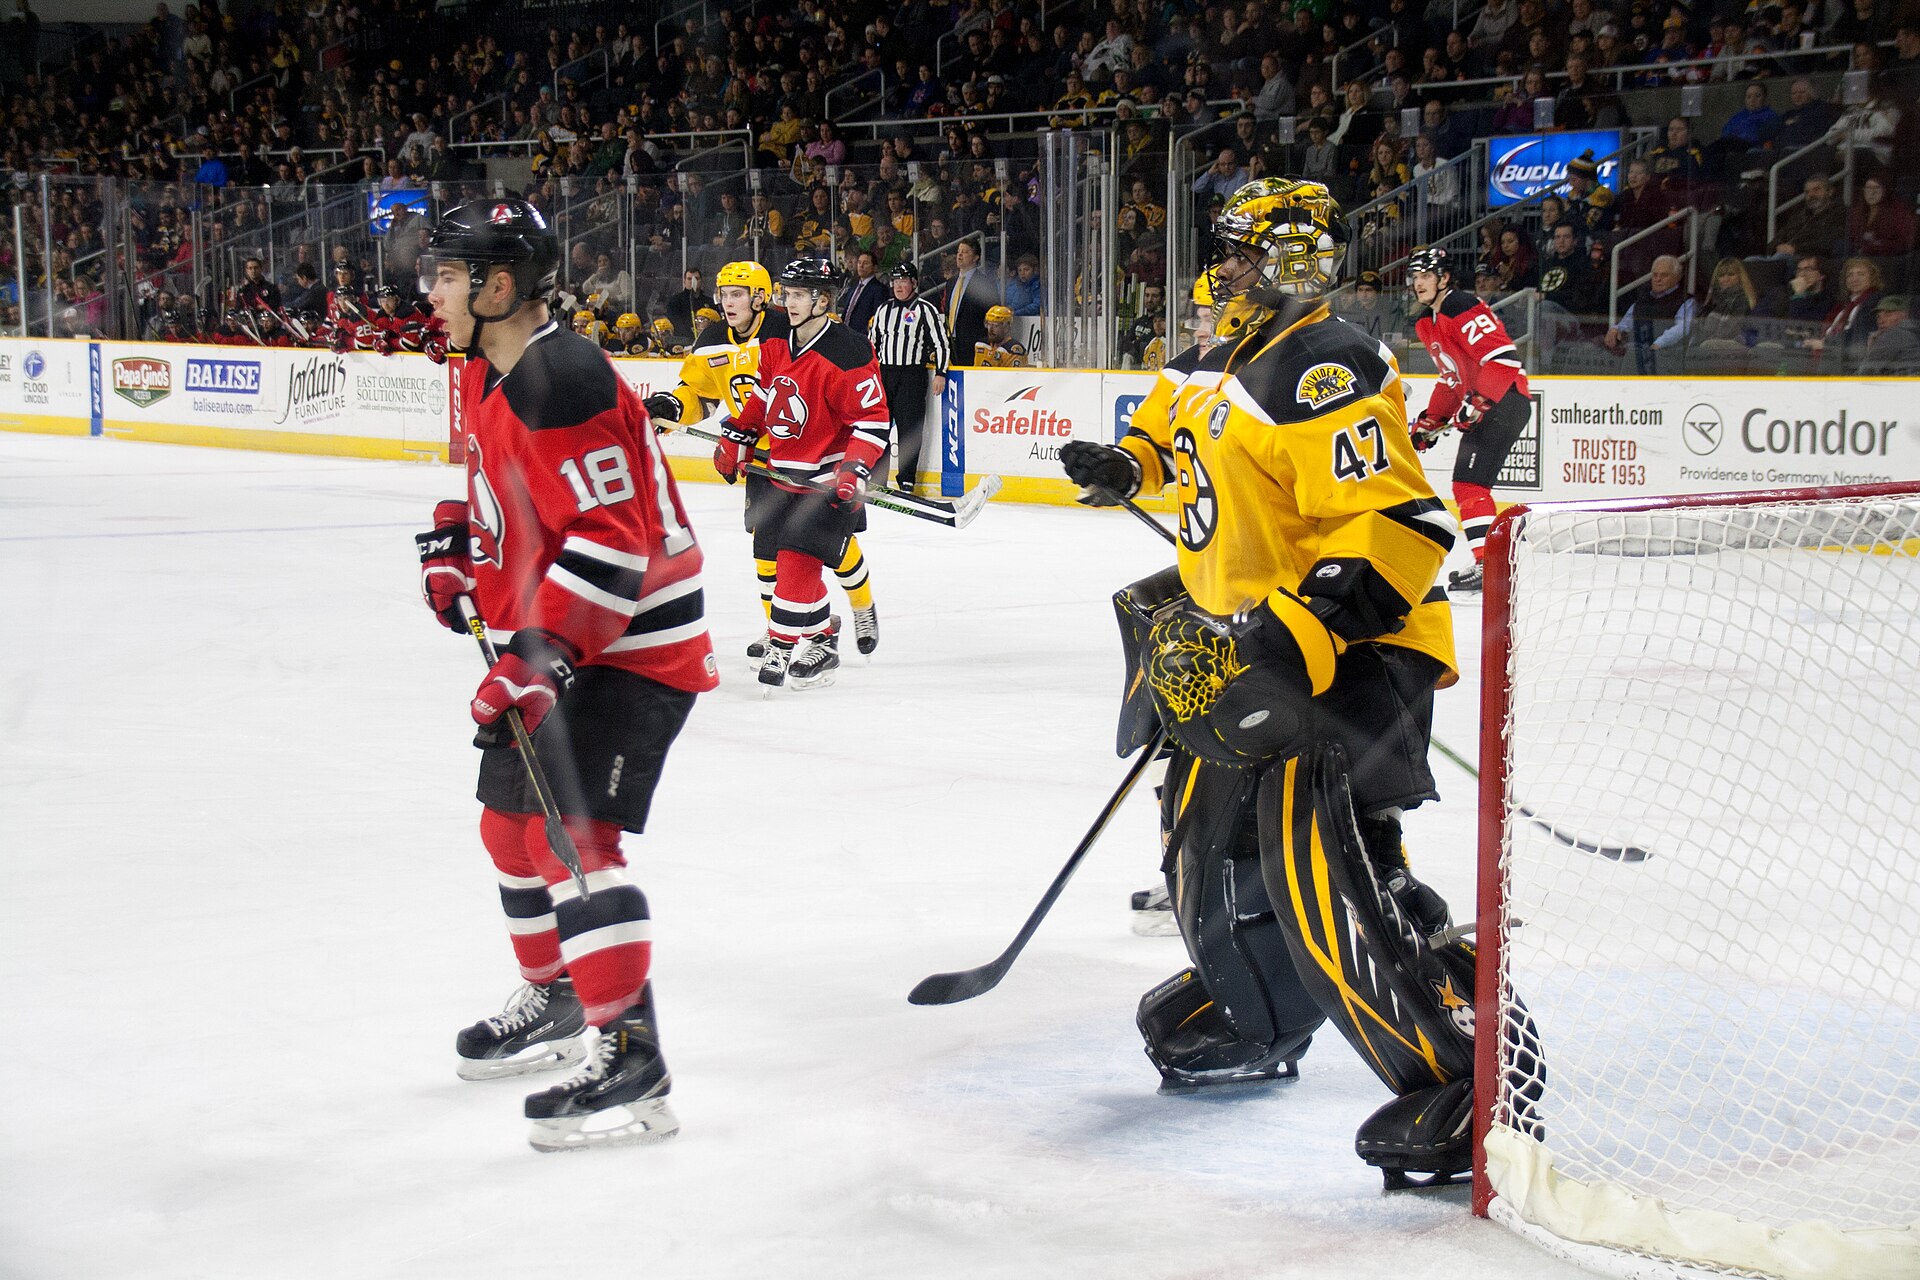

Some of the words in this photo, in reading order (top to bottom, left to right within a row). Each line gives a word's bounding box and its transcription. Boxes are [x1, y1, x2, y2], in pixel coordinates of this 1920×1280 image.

[1500, 164, 1549, 183] BUD
[1548, 160, 1618, 182] LIT
[1461, 313, 1497, 346] 29
[0, 355, 12, 368] EY
[23, 382, 48, 394] FLOOD
[114, 362, 141, 389] Papa
[141, 363, 170, 391] Gino's
[187, 363, 259, 390] BALISE
[356, 375, 376, 388] EAST
[378, 376, 427, 391] COMMERCE
[1301, 367, 1353, 397] PROVIDENCE
[24, 395, 49, 405] LINCOLN
[273, 355, 347, 425] Jordan's
[411, 391, 427, 405] INC
[453, 366, 462, 433] CCM
[856, 374, 884, 409] 21
[193, 397, 254, 414] baliseauto.com
[295, 395, 346, 420] FURNITURE
[1551, 403, 1663, 426] smhearth.com
[948, 378, 959, 468] CCM
[973, 408, 1072, 437] Safelite
[1741, 408, 1898, 456] Condor
[722, 426, 758, 445] CCM
[1029, 442, 1062, 461] Auto
[1332, 417, 1391, 482] 47
[1504, 454, 1536, 467] BECUE
[1573, 438, 1637, 462] TRUSTED
[560, 445, 636, 513] 18
[1497, 468, 1536, 482] ATING
[1562, 463, 1605, 485] SINCE
[1611, 465, 1646, 486] 1953
[1680, 467, 1748, 482] Providence
[1752, 470, 1764, 482] to
[471, 619, 486, 640] CCM
[550, 657, 576, 689] CC
